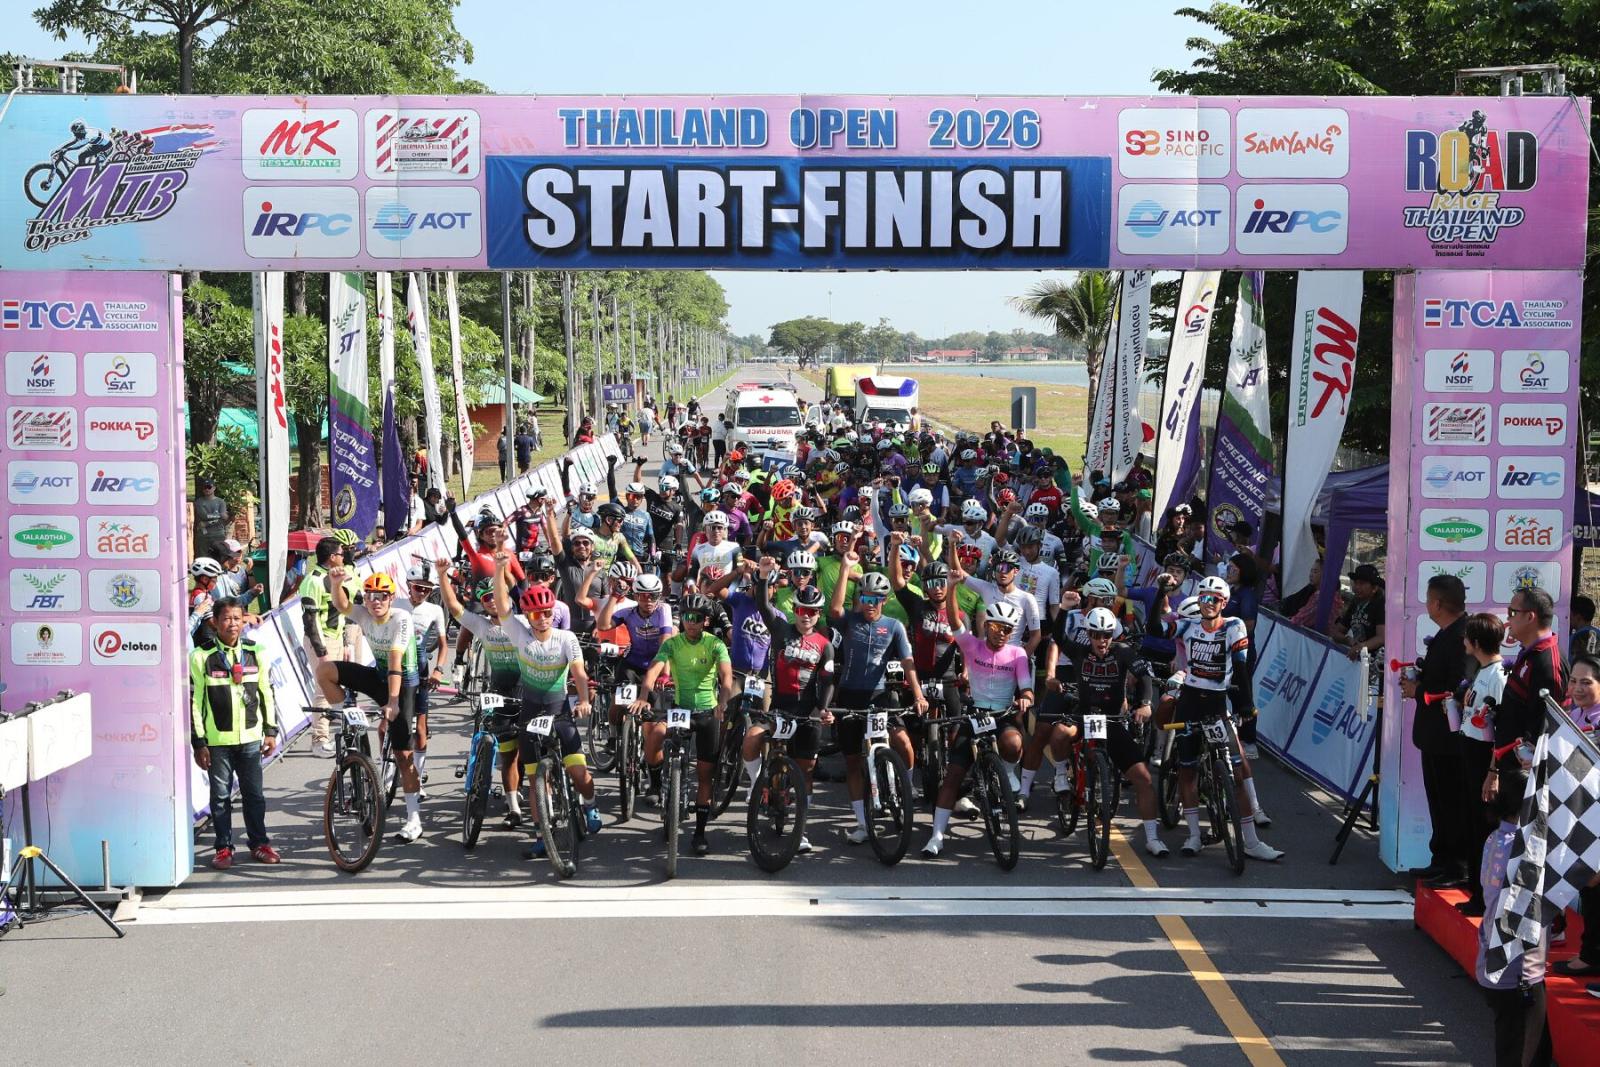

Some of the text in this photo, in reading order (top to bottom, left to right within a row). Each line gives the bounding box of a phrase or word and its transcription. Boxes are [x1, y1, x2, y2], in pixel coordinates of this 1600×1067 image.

[559, 108, 1040, 149] THAILAND OPEN 2026
[1166, 131, 1210, 142] SINO
[260, 119, 340, 156] MK
[1244, 131, 1335, 155] SAMYANG
[1166, 144, 1224, 156] PACIFIC
[260, 159, 340, 168] RESTAURANTS
[1406, 130, 1538, 191] ROAD
[40, 162, 188, 222] MTB
[526, 168, 1061, 248] START-FINISH
[1432, 193, 1498, 209] RACE
[25, 211, 142, 237] Thailand
[418, 213, 471, 230] AOT
[1170, 210, 1221, 227] AOT
[1405, 208, 1522, 226] THAILAND
[24, 228, 93, 252] Open
[1429, 224, 1497, 241] OPEN
[23, 302, 103, 329] TCA
[105, 303, 147, 311] THAILAND
[1445, 301, 1521, 327] TCA
[1298, 310, 1314, 427] RESTAURANTS
[1310, 307, 1358, 419] MK
[27, 379, 56, 388] NSDF
[108, 380, 136, 390] SAT
[1445, 376, 1473, 384] NSDF
[1522, 378, 1549, 386] SAT
[609, 388, 628, 399] 100
[90, 421, 132, 431] POKKA
[1504, 417, 1543, 427] POKKA
[1220, 435, 1268, 484] CREATING
[40, 477, 73, 488] AOT
[1217, 450, 1266, 500] EXCELLENCE
[1454, 471, 1485, 481] AOT
[1216, 466, 1264, 518] IN SPORTS
[98, 534, 149, 553] สสส
[1504, 527, 1554, 545] สสส
[26, 595, 64, 608] FBT
[1191, 650, 1213, 662] VITAL
[1278, 671, 1308, 706] AOT
[672, 712, 686, 723] B4
[872, 718, 885, 731] B3
[1208, 726, 1224, 739] A3
